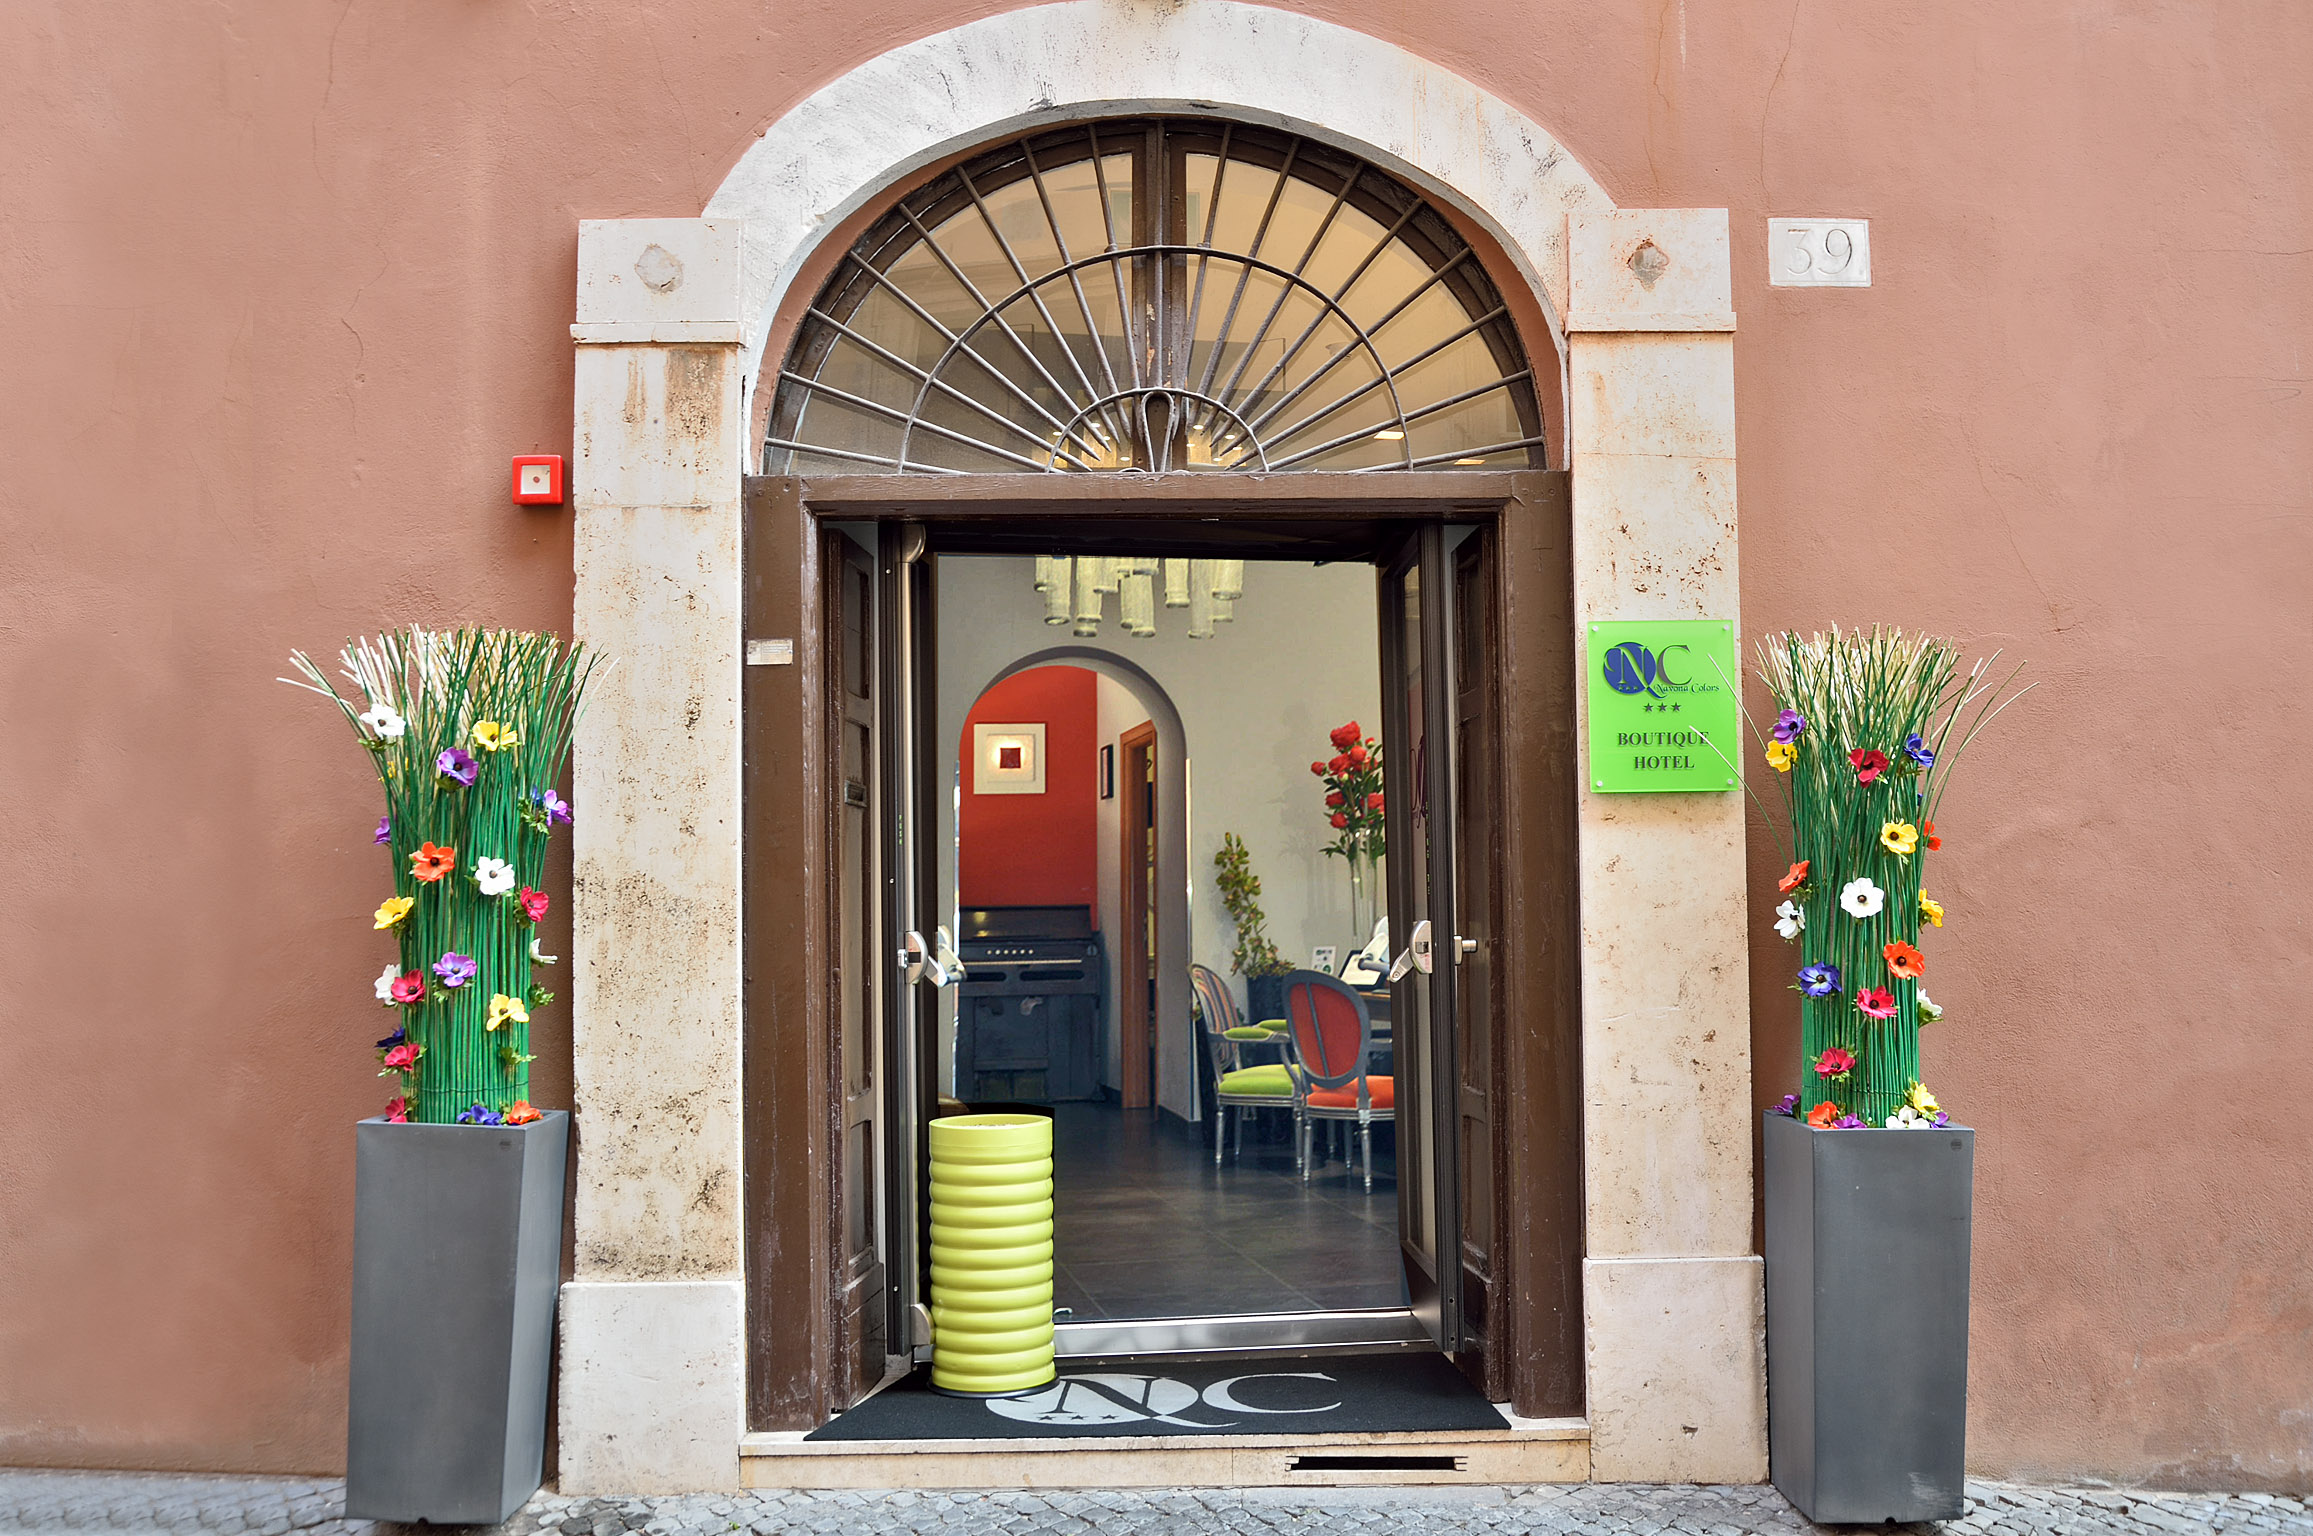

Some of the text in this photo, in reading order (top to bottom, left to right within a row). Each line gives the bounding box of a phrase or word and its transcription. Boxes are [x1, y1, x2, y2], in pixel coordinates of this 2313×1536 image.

[1786, 228, 1853, 275] 39
[1654, 682, 1720, 694] Navona Colors
[1618, 732, 1709, 747] BOUTIQUE
[1634, 756, 1694, 769] HOTEL
